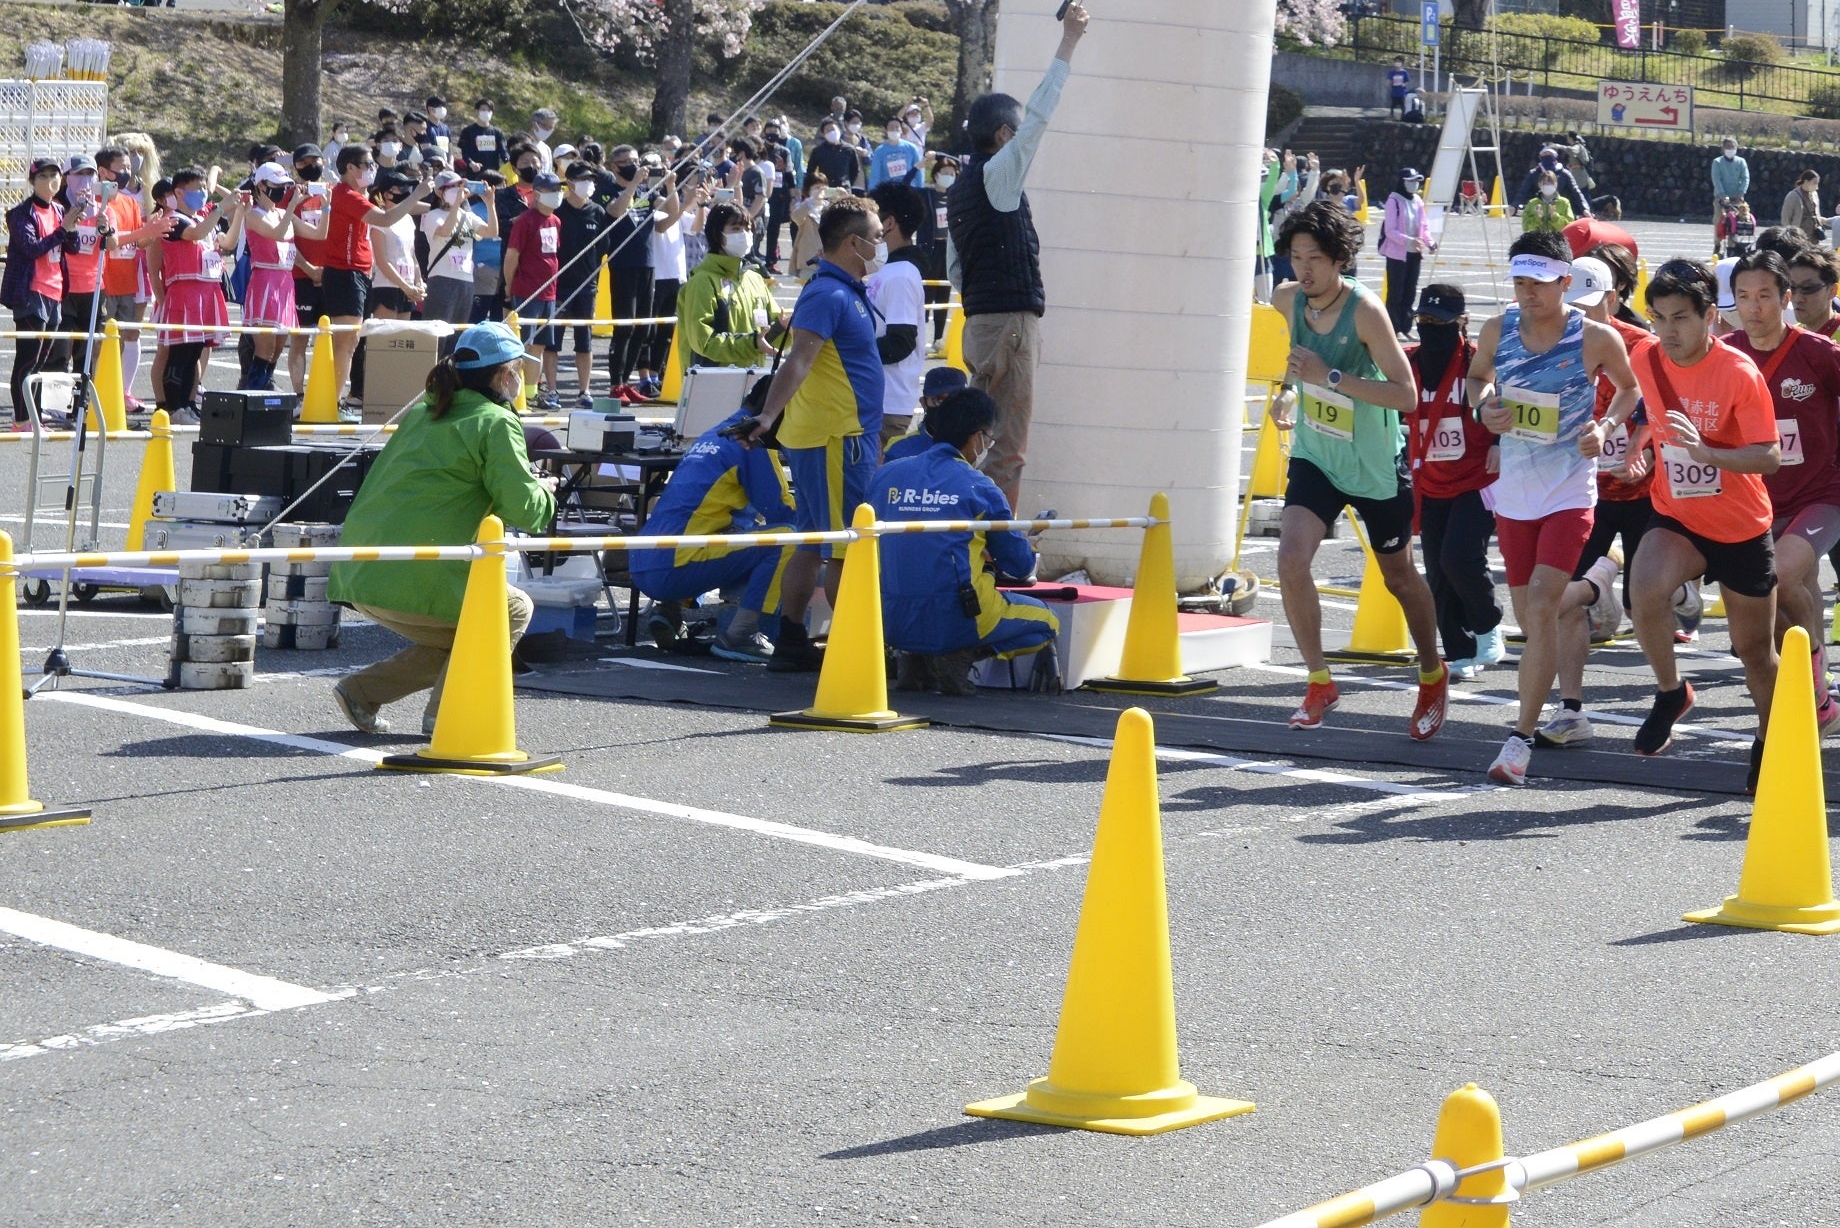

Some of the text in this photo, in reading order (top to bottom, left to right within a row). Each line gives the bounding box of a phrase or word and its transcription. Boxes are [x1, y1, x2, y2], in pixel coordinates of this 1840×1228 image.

[1603, 84, 1689, 104] ゆうえんち
[388, 338, 415, 349] ゴミ箱
[1315, 401, 1338, 422] 19
[1516, 404, 1541, 426] 10
[1602, 437, 1628, 456] 05
[1664, 461, 1718, 484] 1309
[903, 488, 959, 505] R-bies
